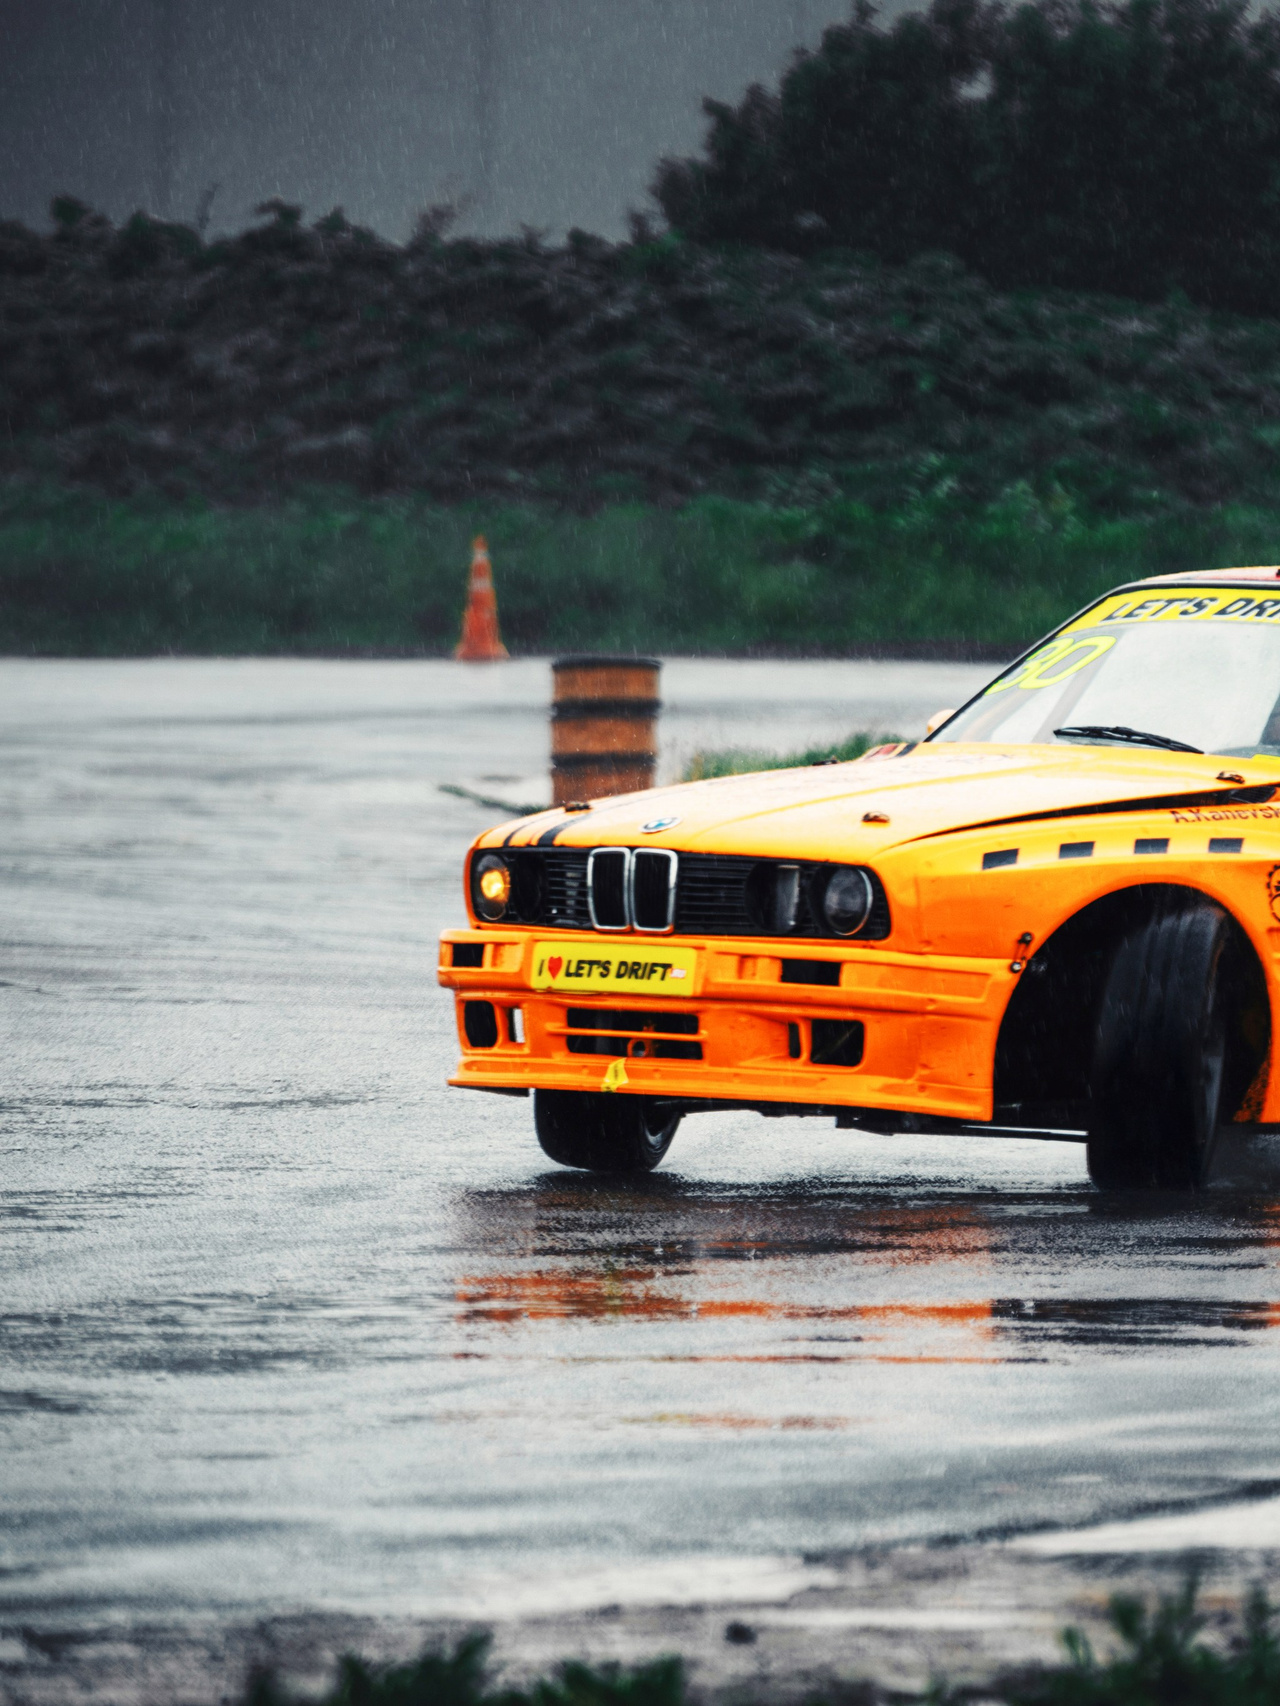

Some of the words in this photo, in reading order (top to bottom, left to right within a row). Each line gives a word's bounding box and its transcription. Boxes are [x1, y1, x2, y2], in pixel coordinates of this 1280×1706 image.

[1099, 597, 1219, 623] LET'S
[538, 959, 545, 976] I
[565, 959, 612, 978] LET'S
